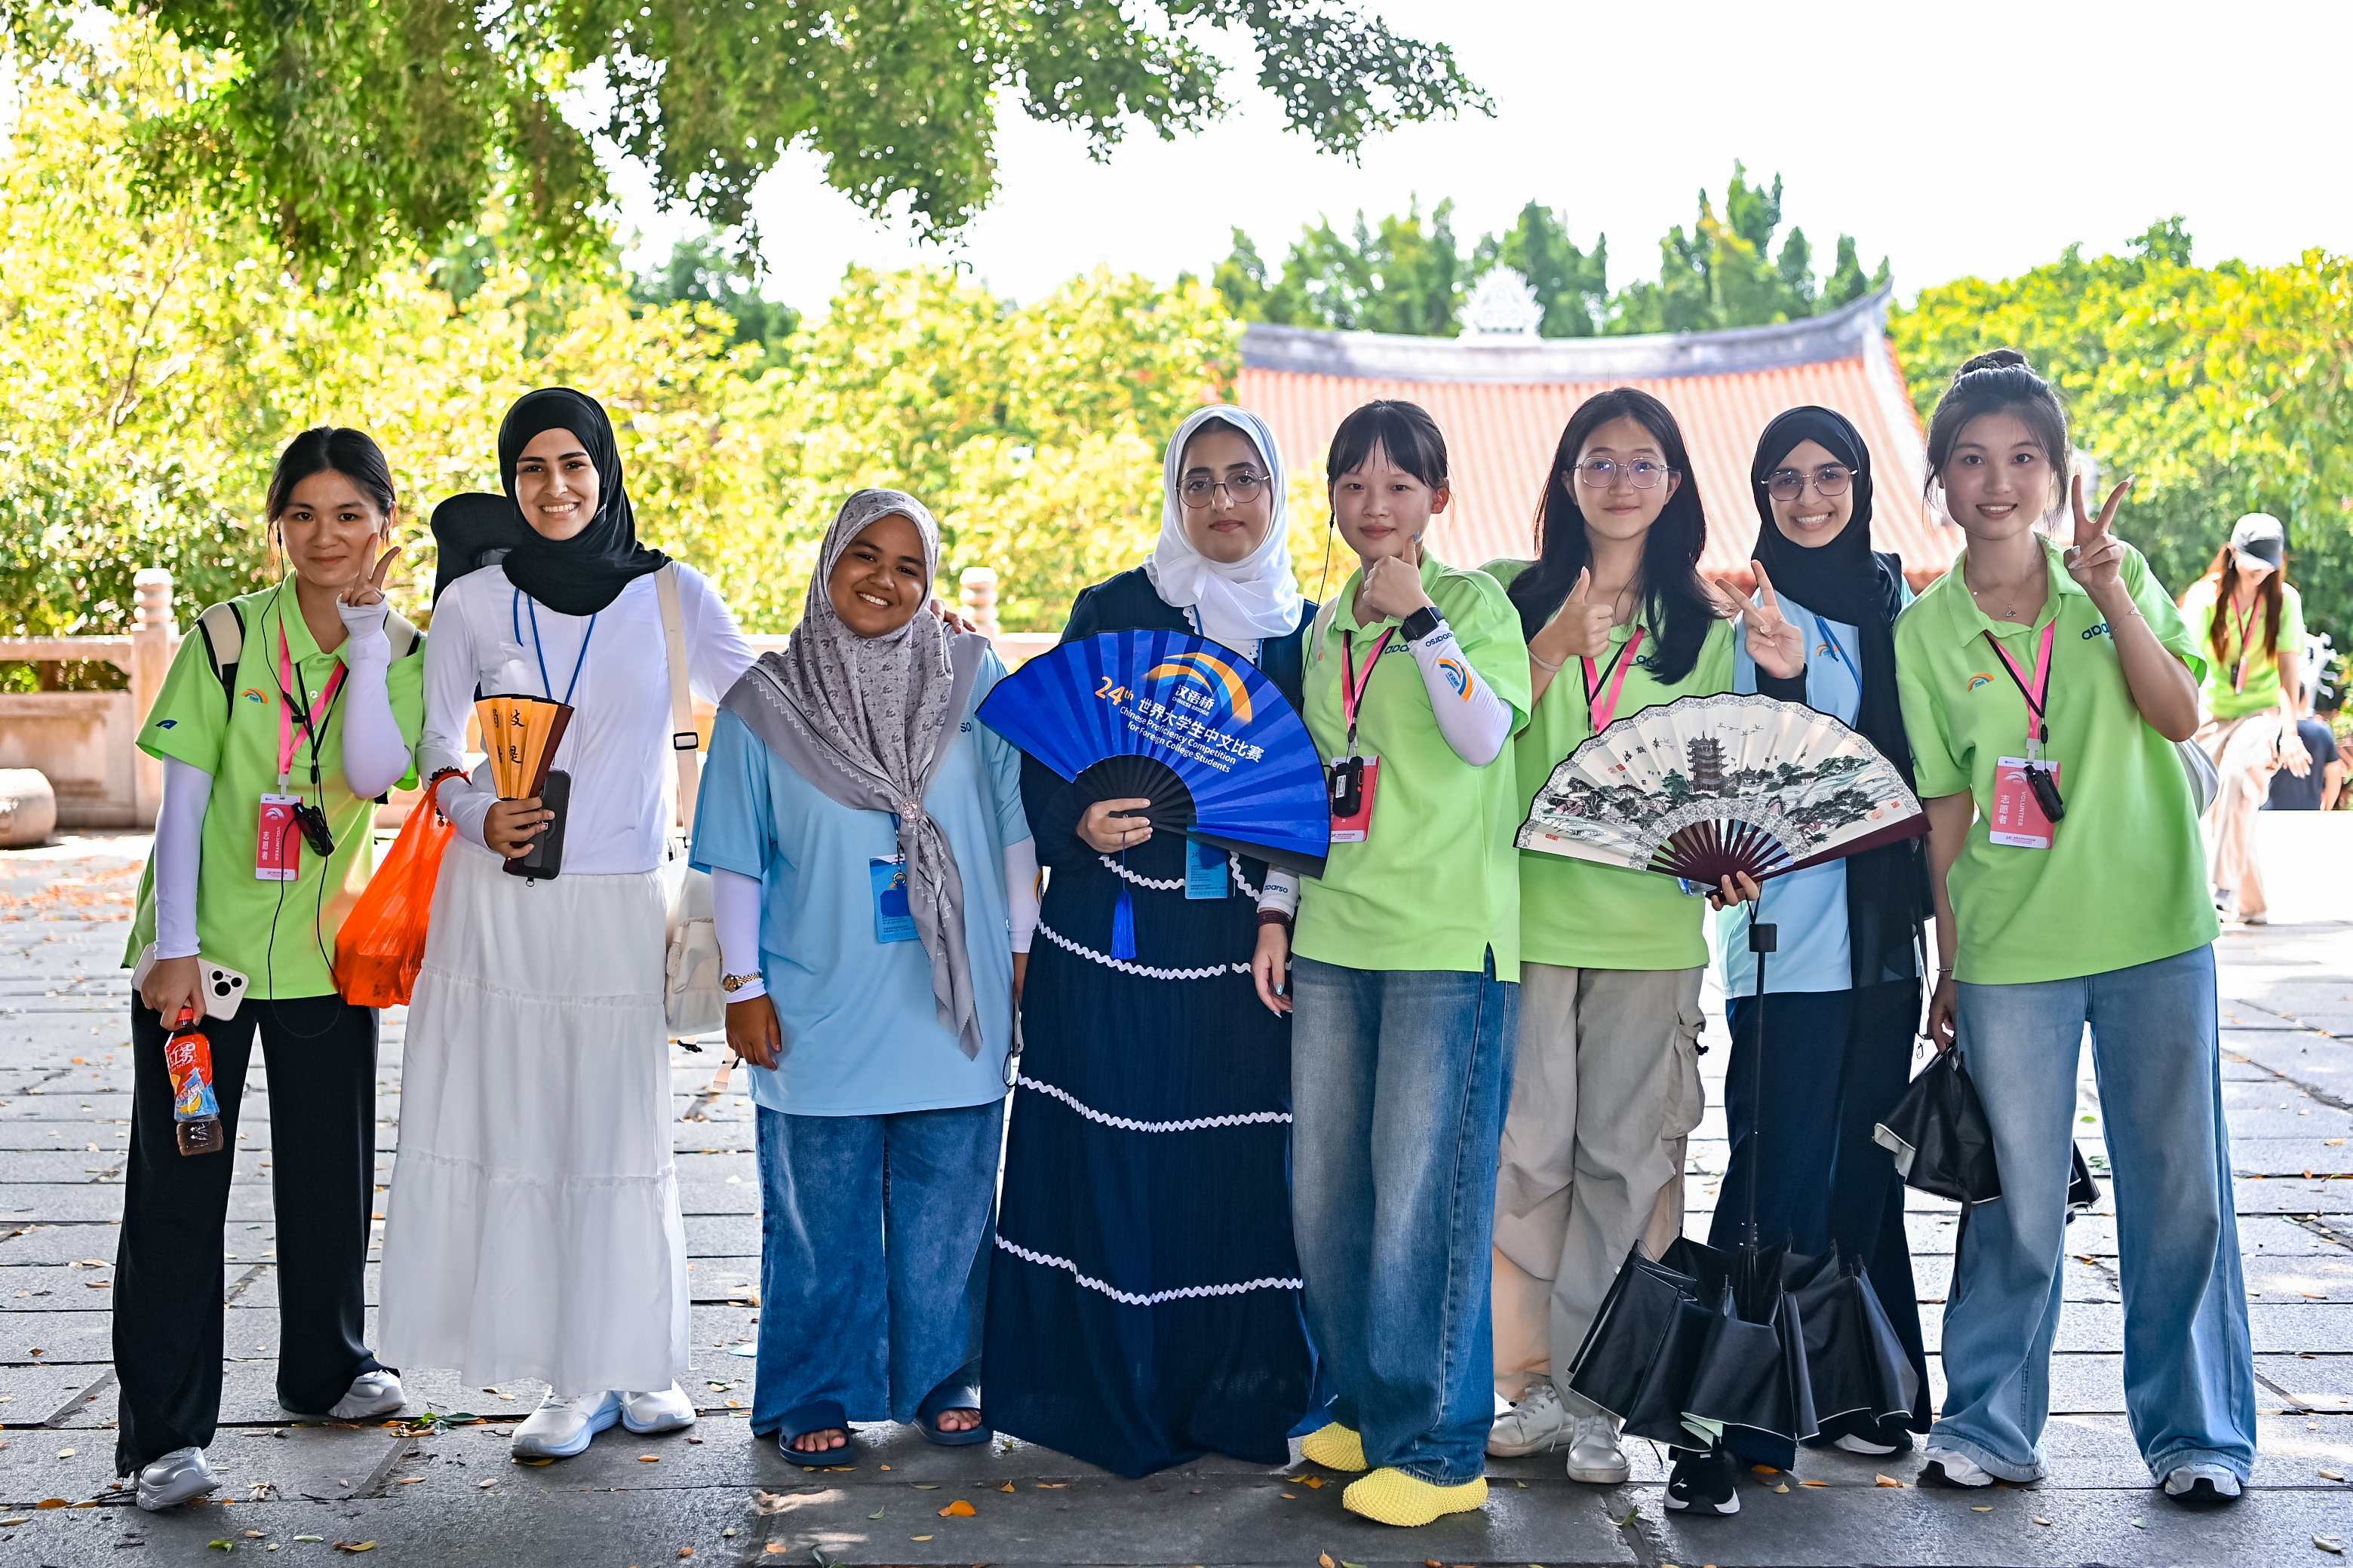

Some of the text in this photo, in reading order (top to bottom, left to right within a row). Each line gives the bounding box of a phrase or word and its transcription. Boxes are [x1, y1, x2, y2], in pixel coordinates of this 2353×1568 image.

[1175, 684, 1215, 710] 汉语桥
[1191, 705, 1210, 716] BRIDGE
[1095, 676, 1265, 763] 24th 世界大学生中文比赛
[1120, 706, 1236, 765] Chinese Proficiency Competition
[1127, 721, 1230, 773] for Foreign College Students
[2017, 791, 2027, 827] VOLUNTEER
